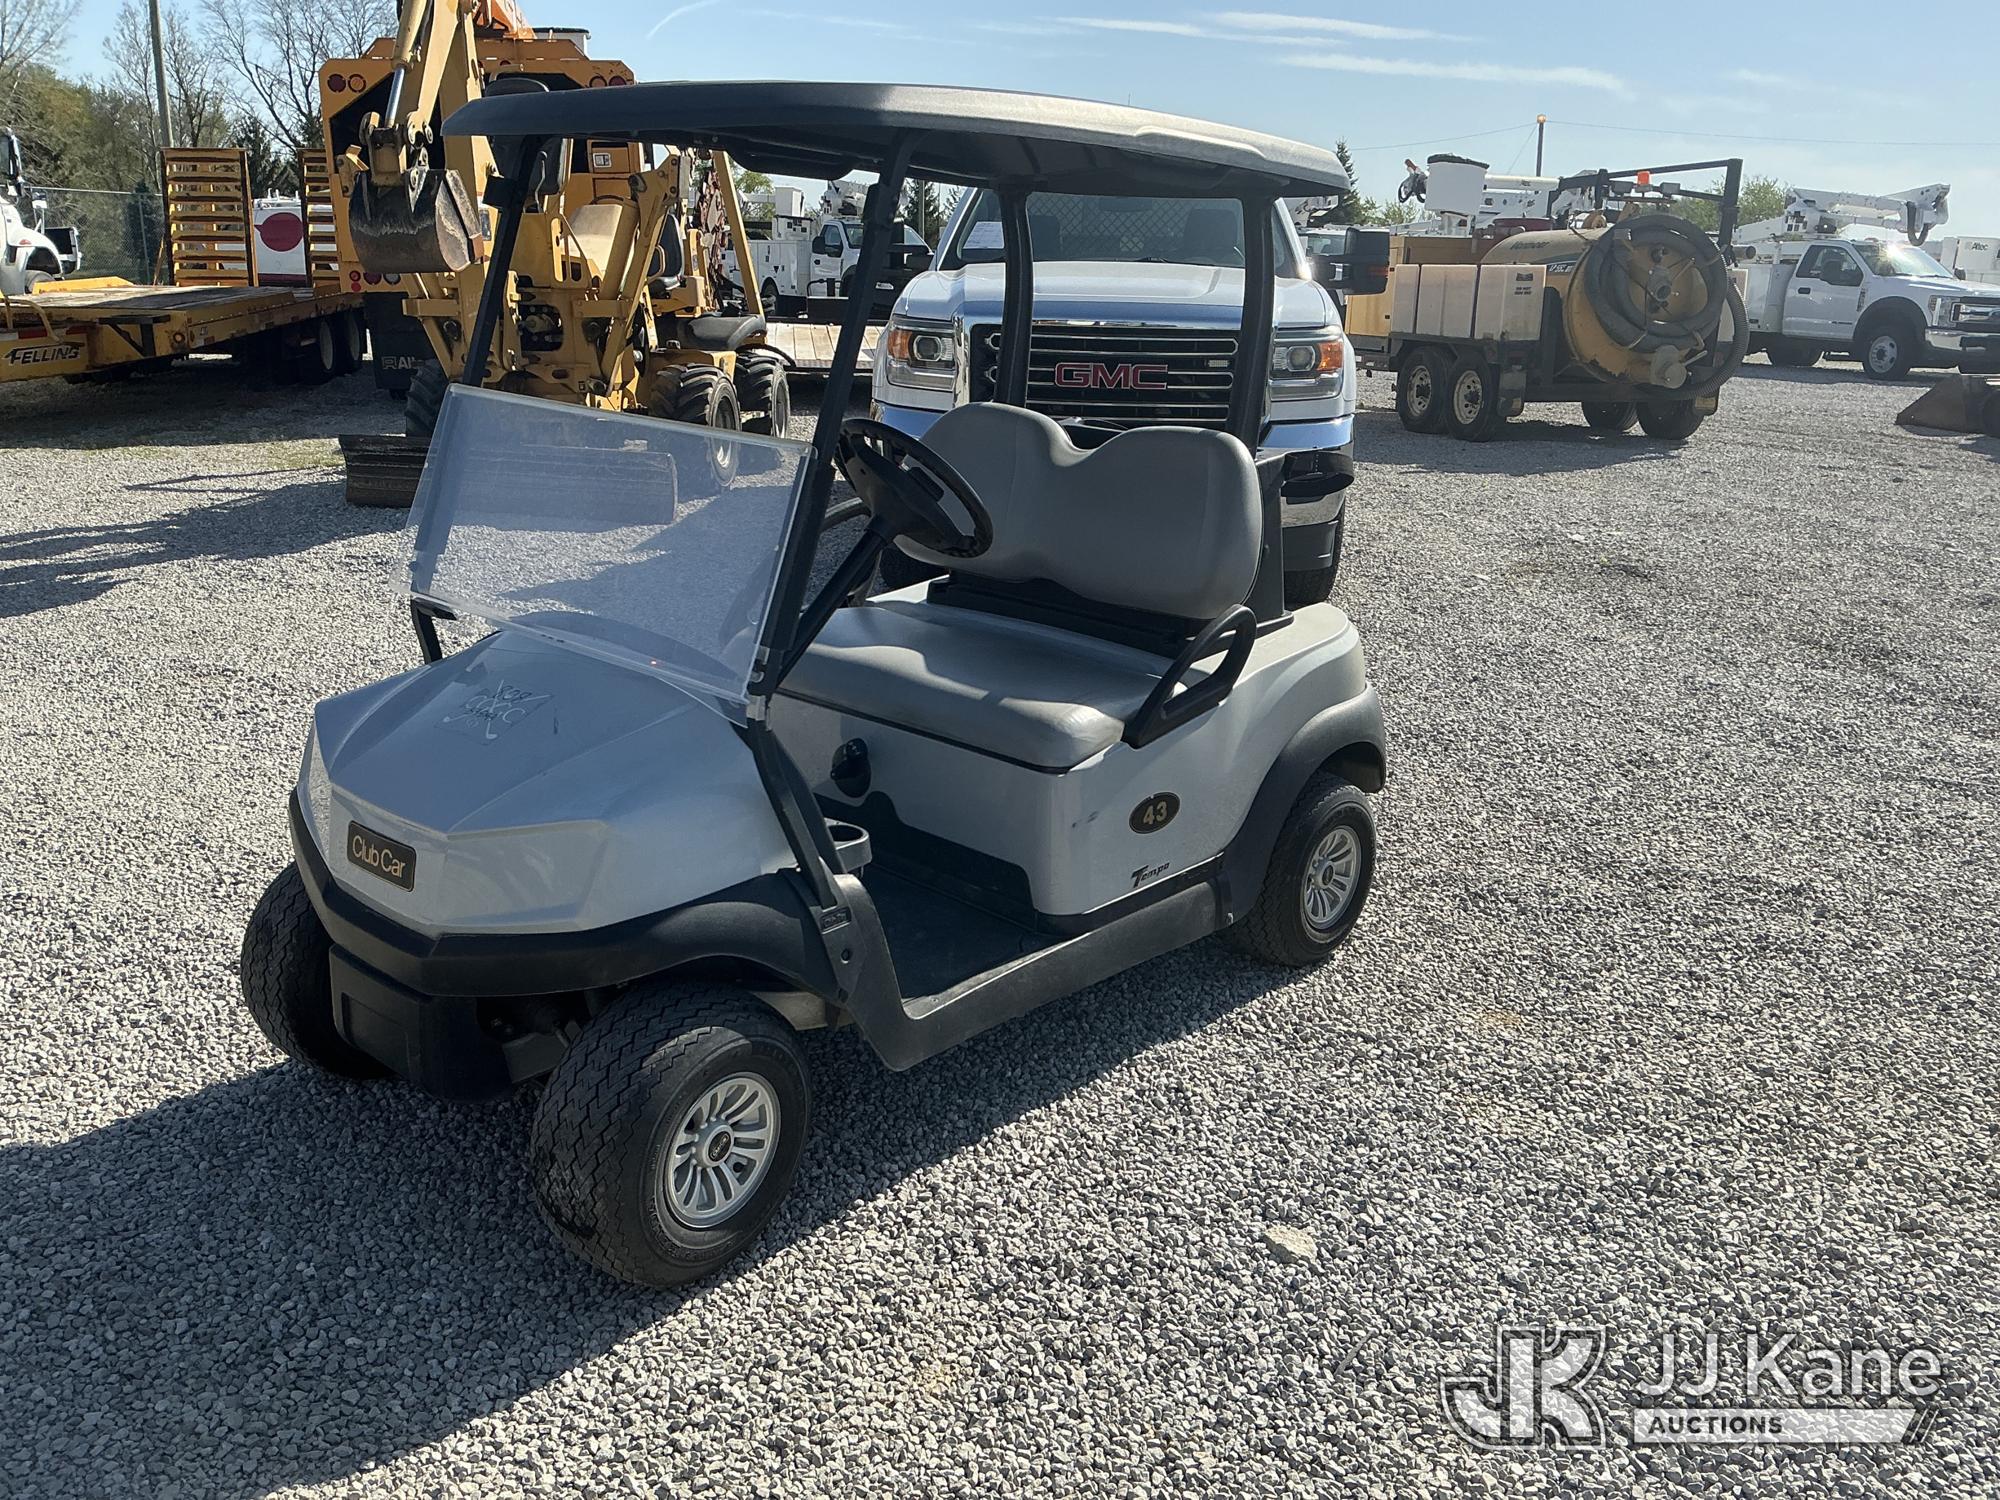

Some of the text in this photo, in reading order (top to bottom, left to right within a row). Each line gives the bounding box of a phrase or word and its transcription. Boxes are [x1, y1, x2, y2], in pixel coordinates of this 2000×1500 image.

[4, 342, 82, 366] FELLING
[1055, 362, 1168, 390] GMC
[1143, 800, 1168, 825] 43
[352, 835, 406, 878] Club Car
[1131, 862, 1170, 888] Tempo
